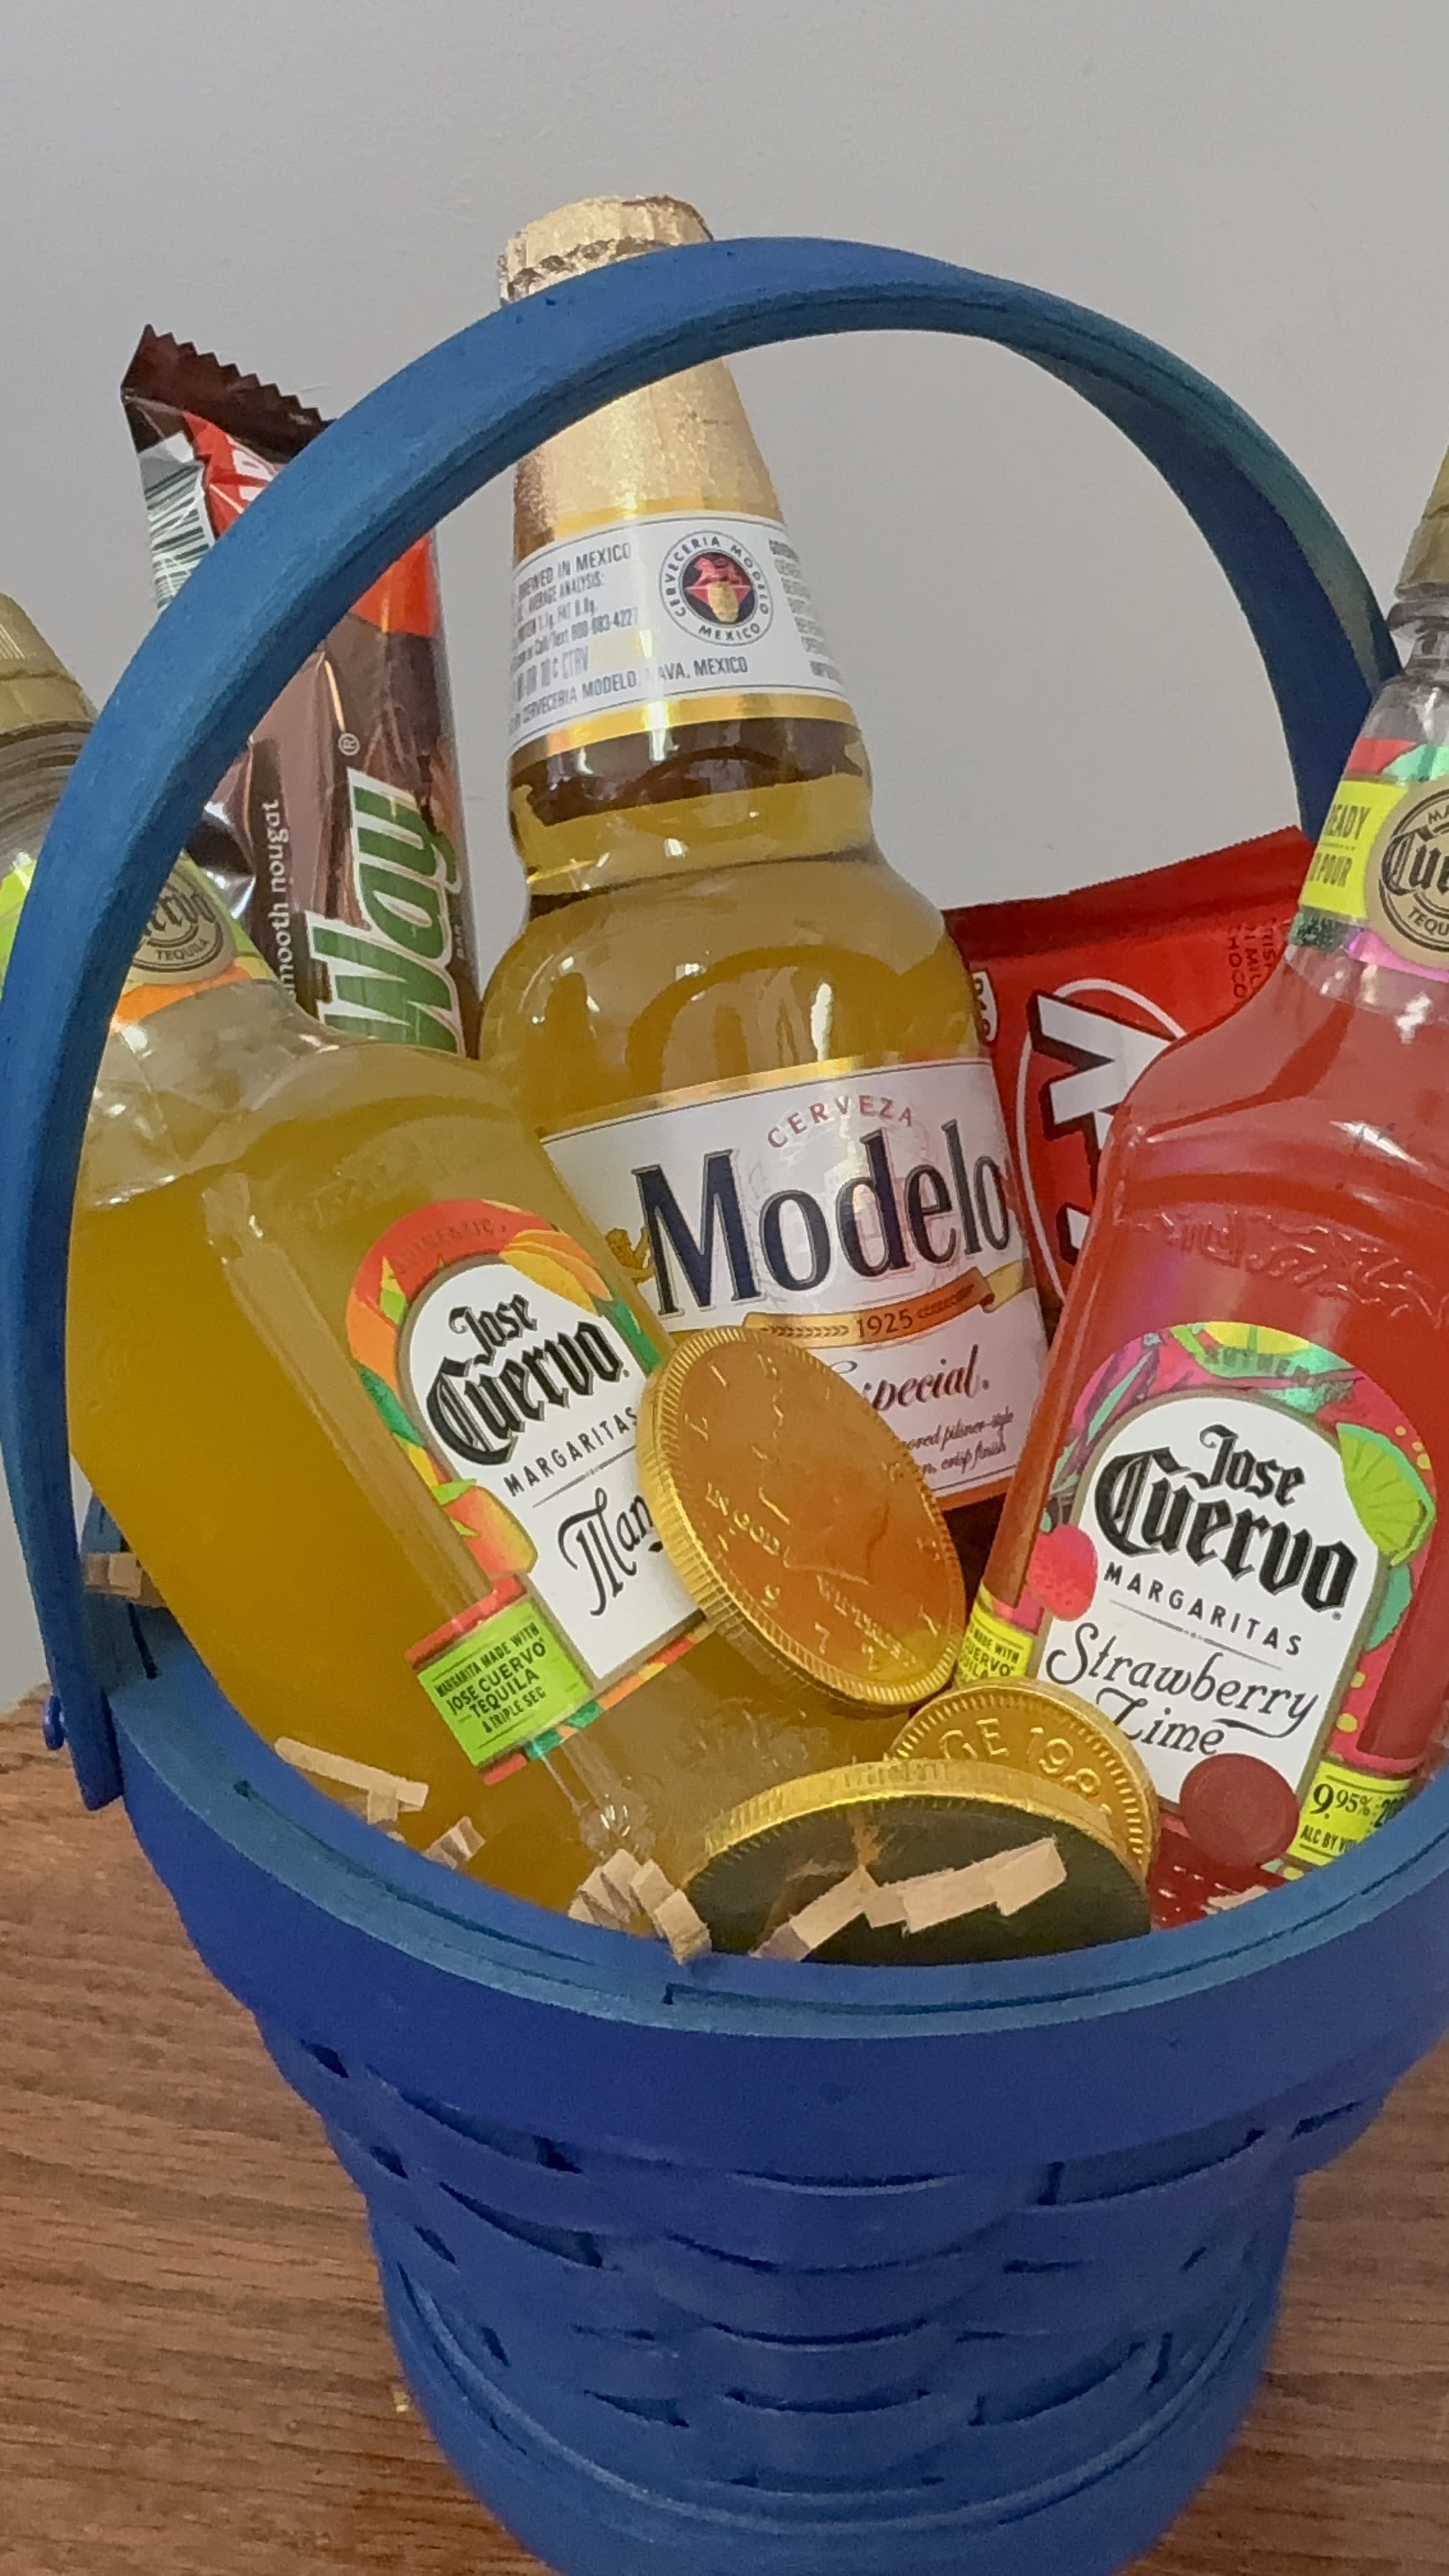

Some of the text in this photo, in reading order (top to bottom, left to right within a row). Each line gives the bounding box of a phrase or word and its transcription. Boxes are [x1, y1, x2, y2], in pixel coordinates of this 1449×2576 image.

[558, 561, 571, 578] IN
[576, 543, 631, 572] MEXICO
[664, 536, 720, 617] CERVECERIA
[699, 623, 760, 641] MEXICO
[523, 686, 578, 724] CERVECERIA
[581, 670, 637, 699] MODELO
[645, 661, 691, 681] AVA,
[693, 656, 748, 677] MEXICO
[260, 799, 289, 893] nougat
[156, 938, 210, 961] TEQUILA
[766, 1094, 914, 1149] CERVEZA
[631, 1118, 1011, 1318] Modelo
[448, 1293, 538, 1367] Jose
[855, 1307, 914, 1338] 1925
[424, 1320, 624, 1466] Cuervo
[862, 1343, 981, 1412] pecial
[503, 1405, 638, 1497] MARGARITAS
[1186, 1423, 1306, 1508] Jose
[558, 1487, 664, 1617] Man
[1094, 1446, 1358, 1613] Cuervo
[1103, 1561, 1302, 1656] MARGARITAS
[433, 1622, 540, 1698] MARGARITA MADE WITH
[445, 1640, 547, 1716] JOSE CUERVO
[994, 1642, 1020, 1664] WITH
[1045, 1622, 1319, 1738] Strawberry
[468, 1666, 540, 1719] TEQUILA
[490, 1699, 524, 1729] TRIPLE
[521, 1685, 547, 1707] SEC
[1095, 1687, 1226, 1755] Lime
[1025, 1726, 1113, 1815] 198
[1299, 1824, 1322, 1845] ALC
[1321, 1831, 1340, 1851] BY
